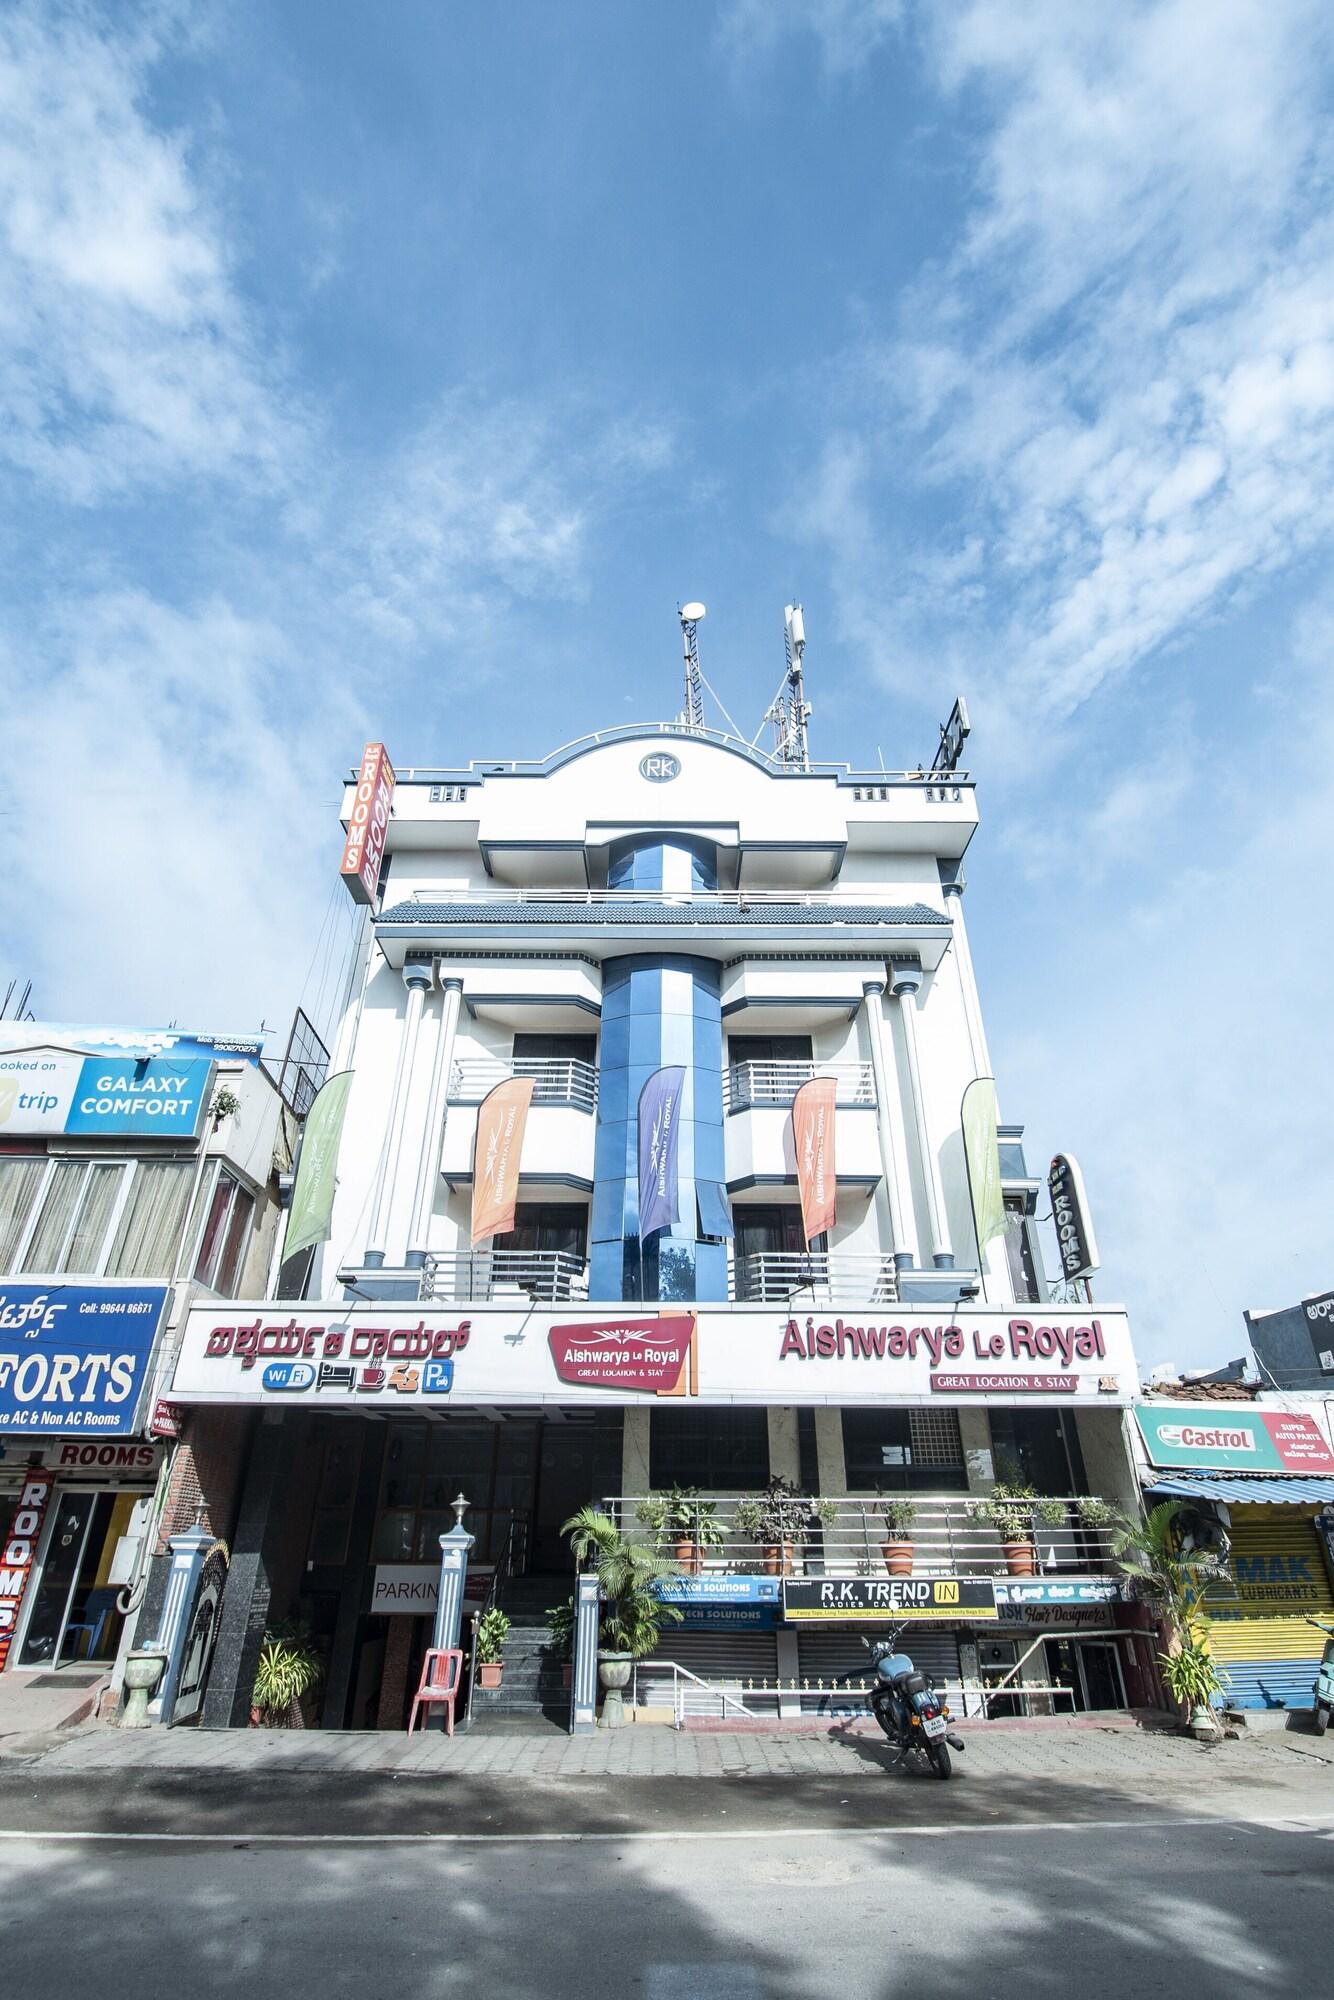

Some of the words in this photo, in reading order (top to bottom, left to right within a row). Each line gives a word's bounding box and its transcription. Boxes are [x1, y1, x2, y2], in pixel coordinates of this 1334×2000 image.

[646, 759, 675, 777] RK
[346, 762, 377, 869] ROOMS
[41, 1063, 57, 1071] on
[97, 1076, 188, 1093] GALAXY
[18, 1091, 58, 1114] trip
[80, 1098, 192, 1116] COMFORT
[1054, 1195, 1081, 1272] ROOMS
[80, 1303, 98, 1314] Cell:
[100, 1303, 126, 1314] 99644
[127, 1303, 153, 1314] 86671
[351, 1320, 472, 1358] ರಾಯಲ್
[780, 1316, 966, 1366] Aishwarya
[975, 1330, 1006, 1357] Le
[1009, 1319, 1107, 1366] Royal
[564, 1348, 630, 1365] Aishwarya
[632, 1351, 643, 1360] Le
[644, 1348, 680, 1366] Royal
[578, 1369, 599, 1377] GREAT
[602, 1369, 636, 1377] LOCATION
[639, 1369, 645, 1377] &
[647, 1369, 664, 1377] STAY
[937, 1376, 970, 1387] GREAT
[976, 1376, 1028, 1387] LOCATION
[1033, 1376, 1042, 1387] &
[1046, 1376, 1072, 1387] STAY
[12, 1411, 29, 1424] AC
[30, 1411, 39, 1424] &
[41, 1411, 63, 1424] Non
[65, 1411, 83, 1425] AC
[83, 1412, 120, 1425] Rooms
[1182, 1428, 1250, 1448] Castrol
[1275, 1432, 1296, 1440] AUTO
[60, 1444, 155, 1466] ROOMS
[1235, 1555, 1313, 1583] MAK
[375, 1582, 440, 1599] PARKIN
[703, 1583, 751, 1593] SOLUTIONS
[821, 1583, 858, 1600] R.K.
[864, 1583, 930, 1600] TREND
[937, 1584, 956, 1600] IN
[1240, 1584, 1319, 1600] LUBRICANTS
[684, 1609, 704, 1618] ECH
[706, 1610, 761, 1619] SOLUTIONS
[998, 1603, 1023, 1621] ISH
[1025, 1604, 1051, 1622] Hair
[1052, 1605, 1107, 1626] Designers
